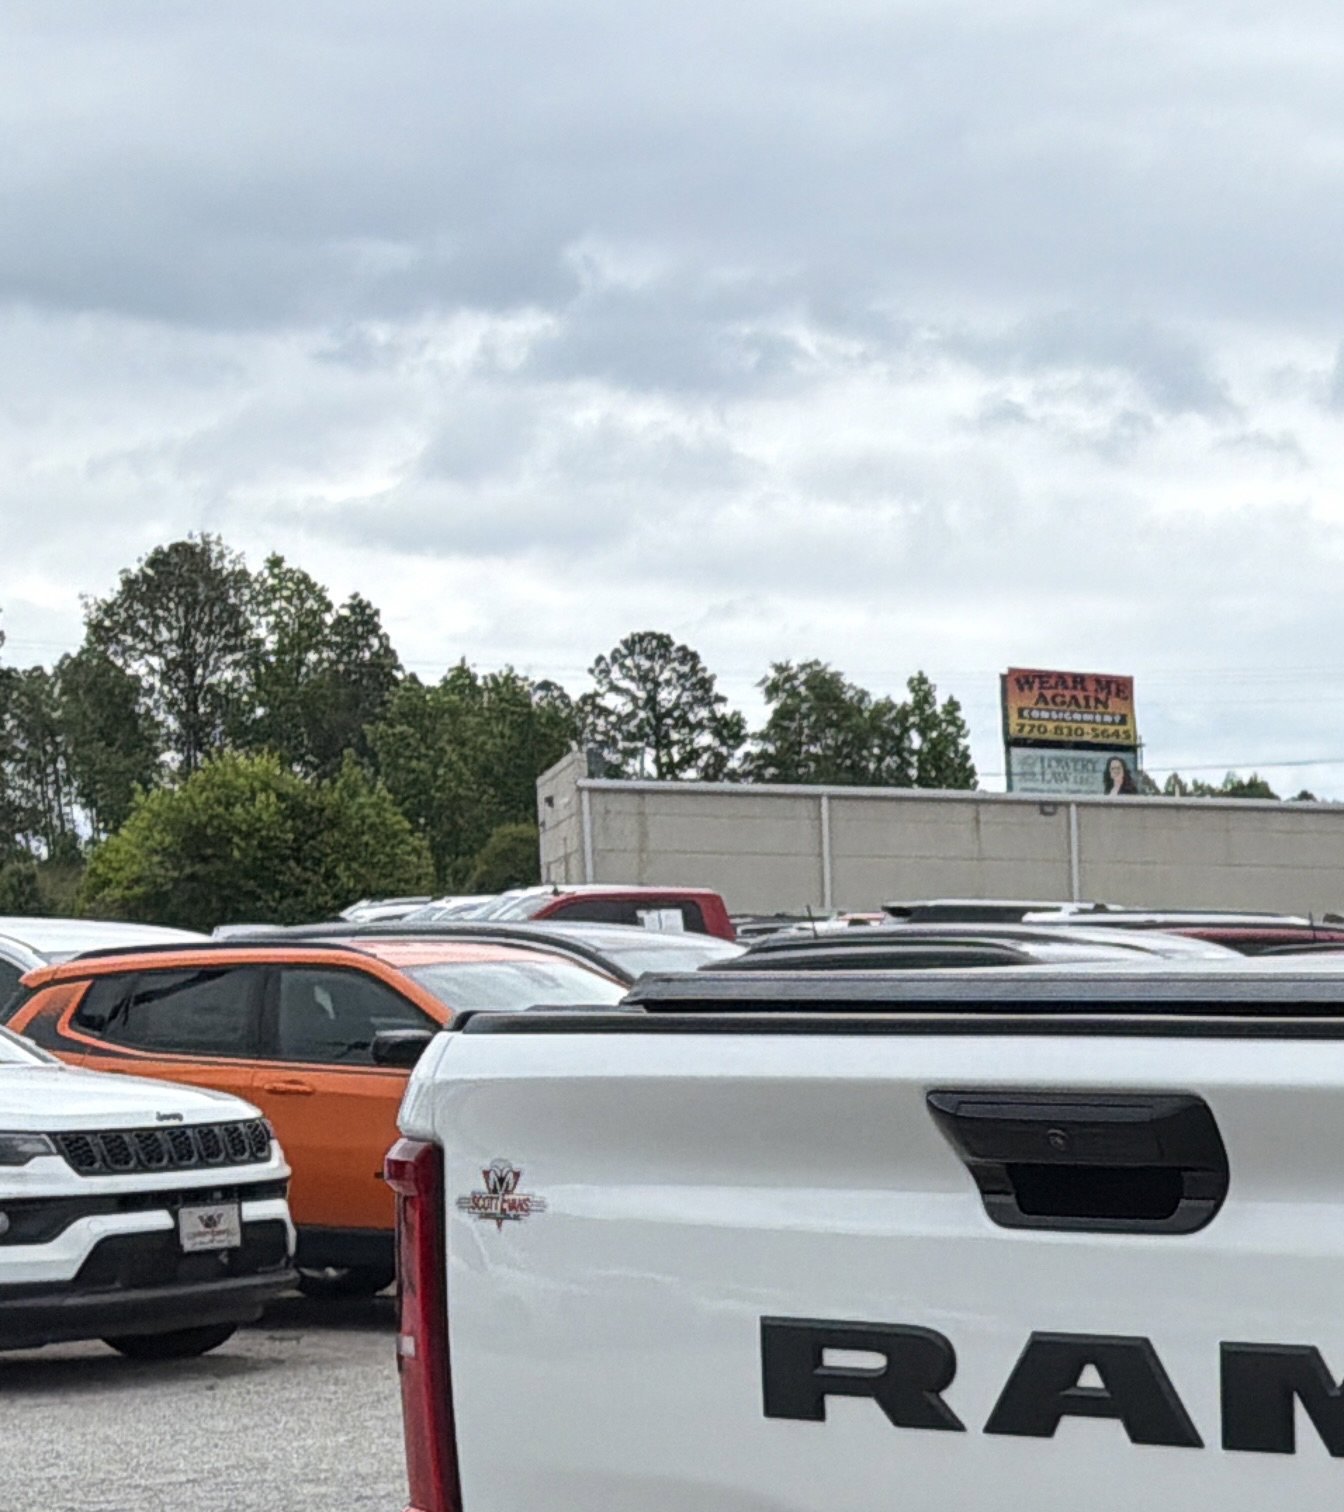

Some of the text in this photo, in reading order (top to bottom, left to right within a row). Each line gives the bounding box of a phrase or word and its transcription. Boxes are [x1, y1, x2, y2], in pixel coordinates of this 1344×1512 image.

[1015, 674, 1130, 701] WEAR ME
[1034, 692, 1109, 710] AGAIN
[1022, 709, 1121, 723] CONSIGNMENT
